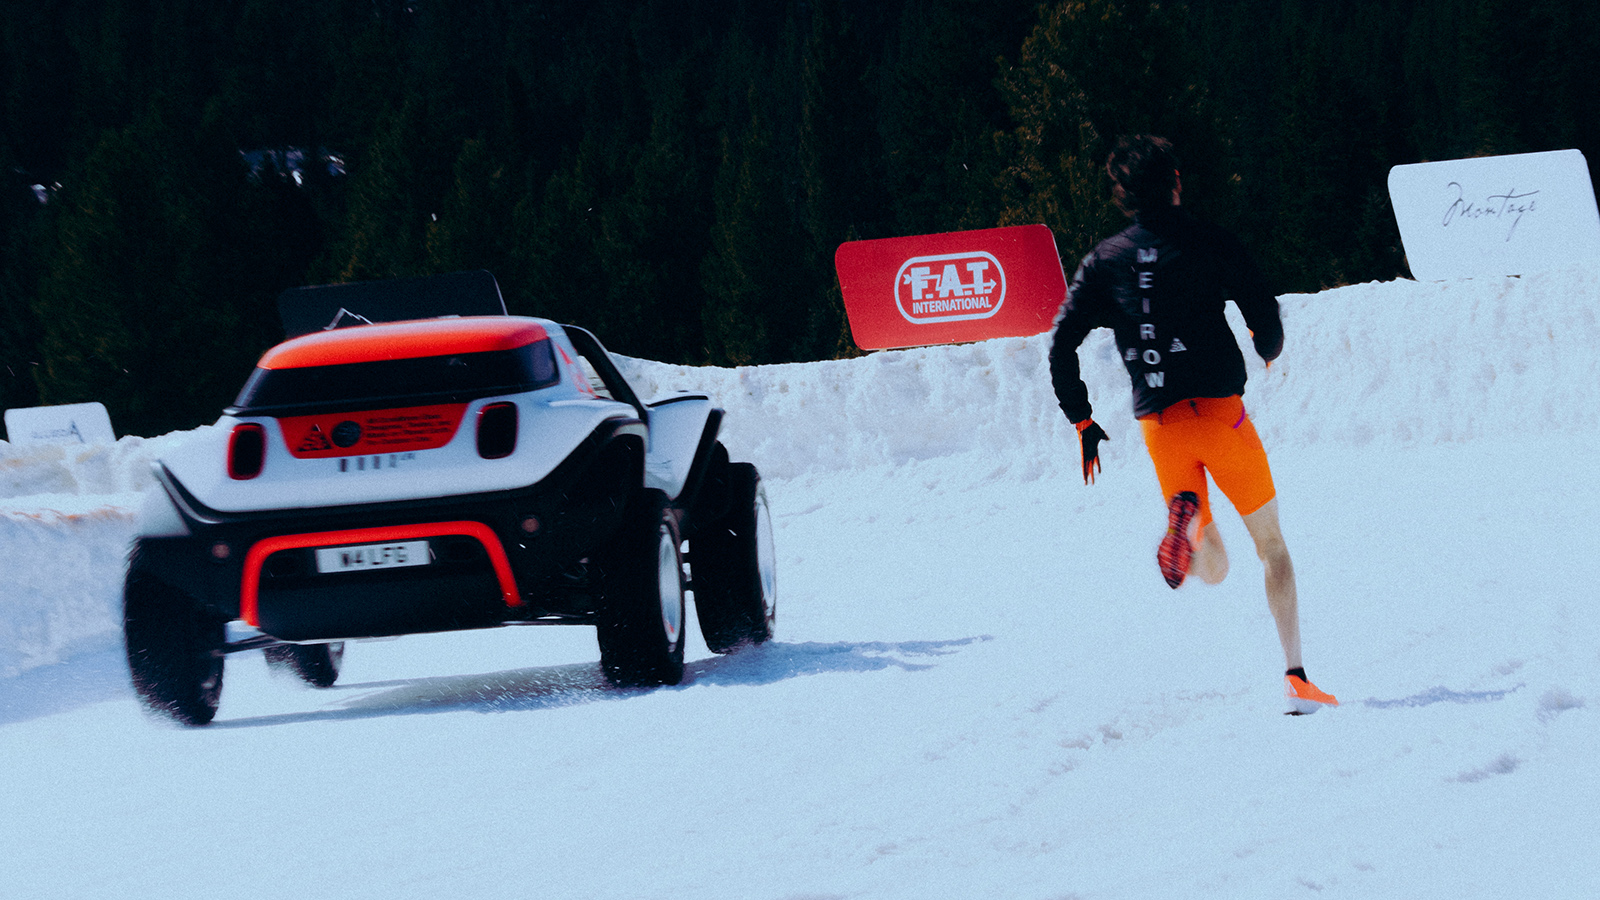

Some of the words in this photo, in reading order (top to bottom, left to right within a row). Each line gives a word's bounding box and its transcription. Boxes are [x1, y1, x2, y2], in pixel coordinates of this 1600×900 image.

[1442, 181, 1540, 242] Montage
[910, 261, 993, 300] F.A.T.
[912, 296, 992, 314] INTERNATIONAL
[1137, 247, 1165, 388] MEIROW
